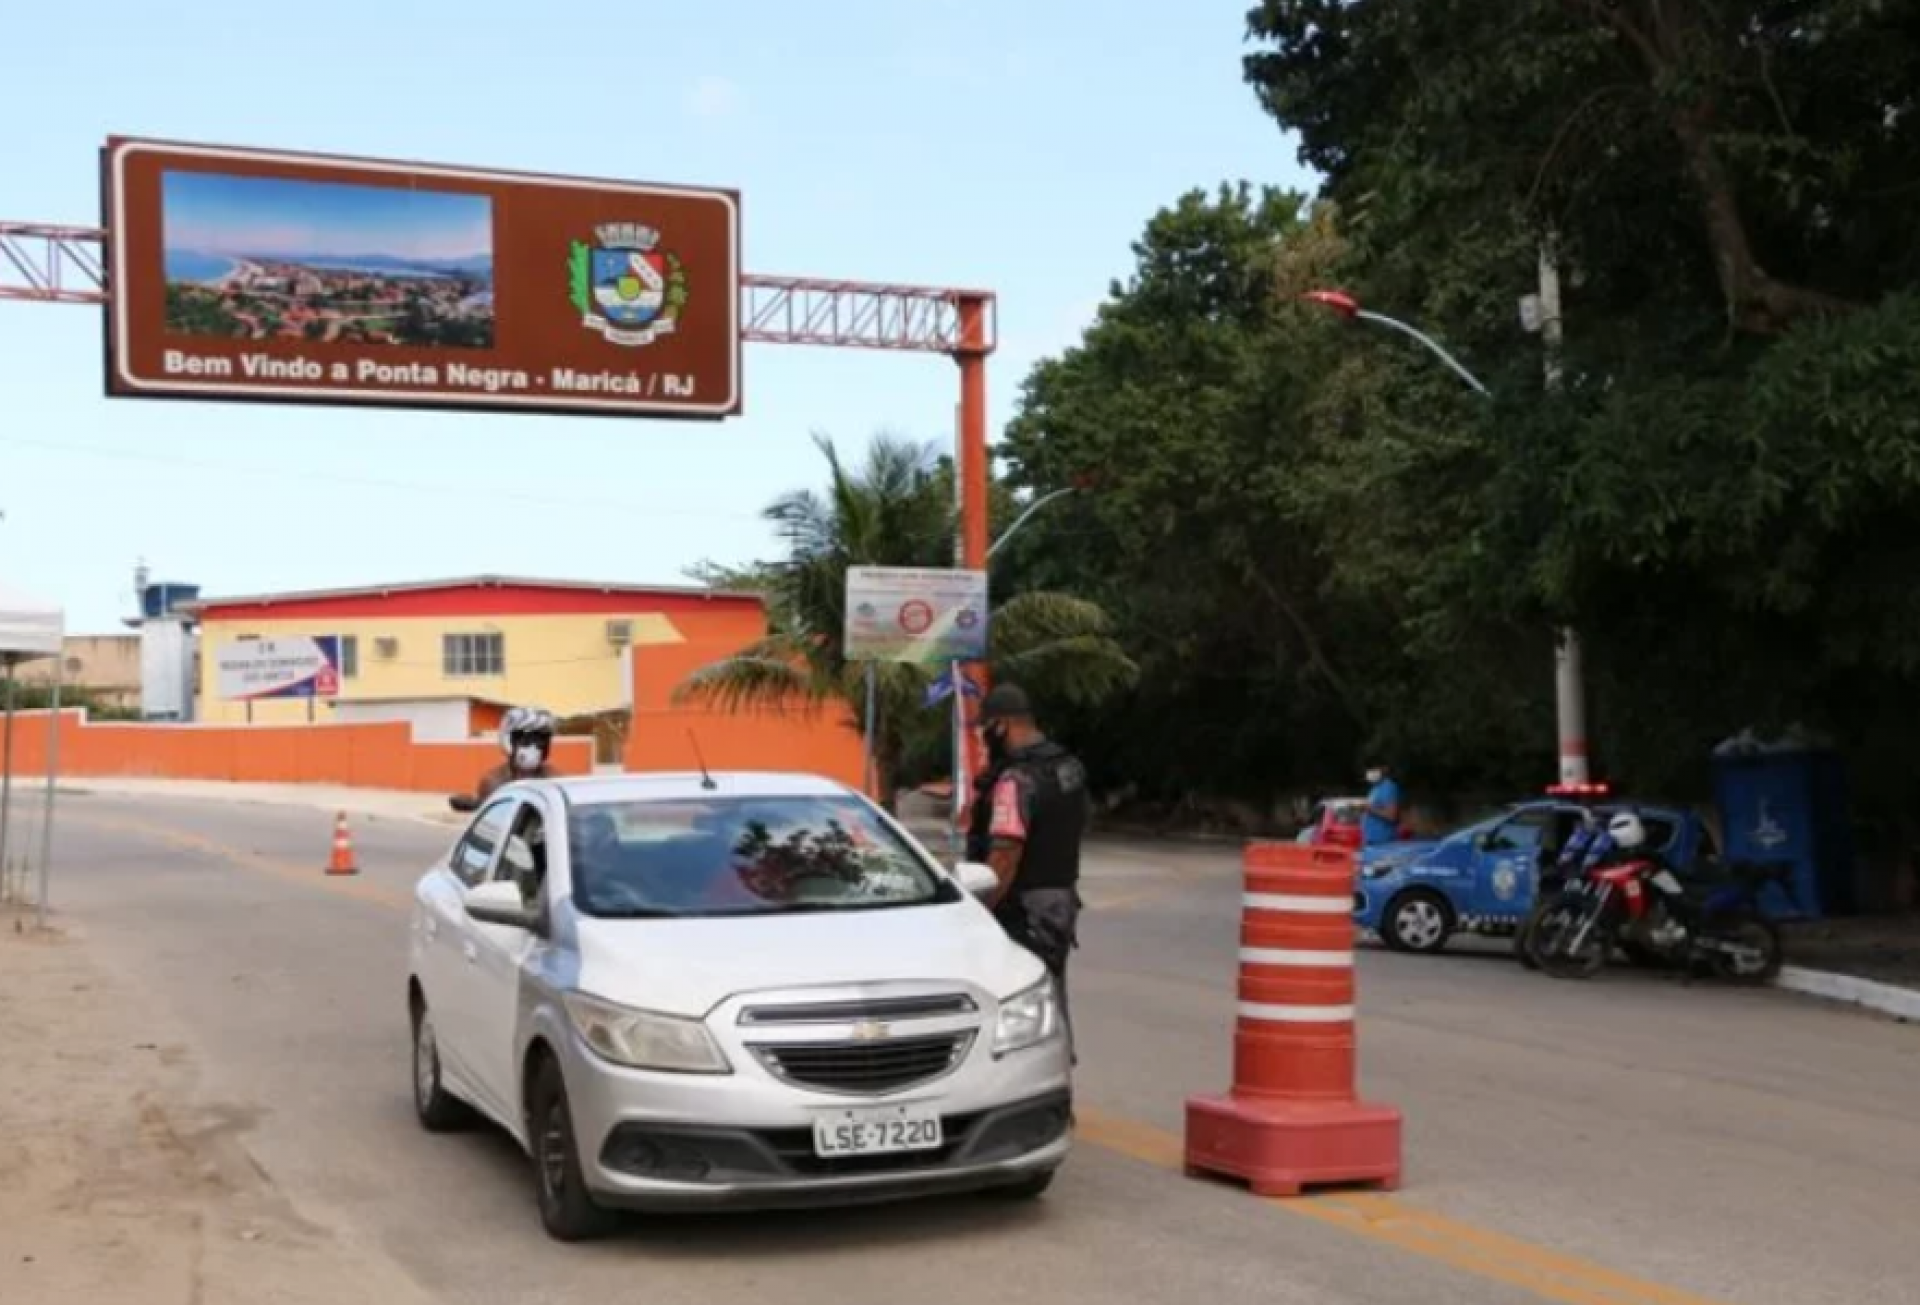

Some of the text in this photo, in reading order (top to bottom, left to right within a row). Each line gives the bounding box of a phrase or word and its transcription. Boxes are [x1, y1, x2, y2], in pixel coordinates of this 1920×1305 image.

[163, 350, 232, 374] Bem
[240, 353, 322, 379] Vindo
[331, 362, 348, 380] a
[357, 358, 438, 384] Ponta
[446, 363, 528, 392] Negra
[552, 367, 640, 394] Maricá
[647, 373, 658, 396] /
[663, 373, 695, 397] RJ
